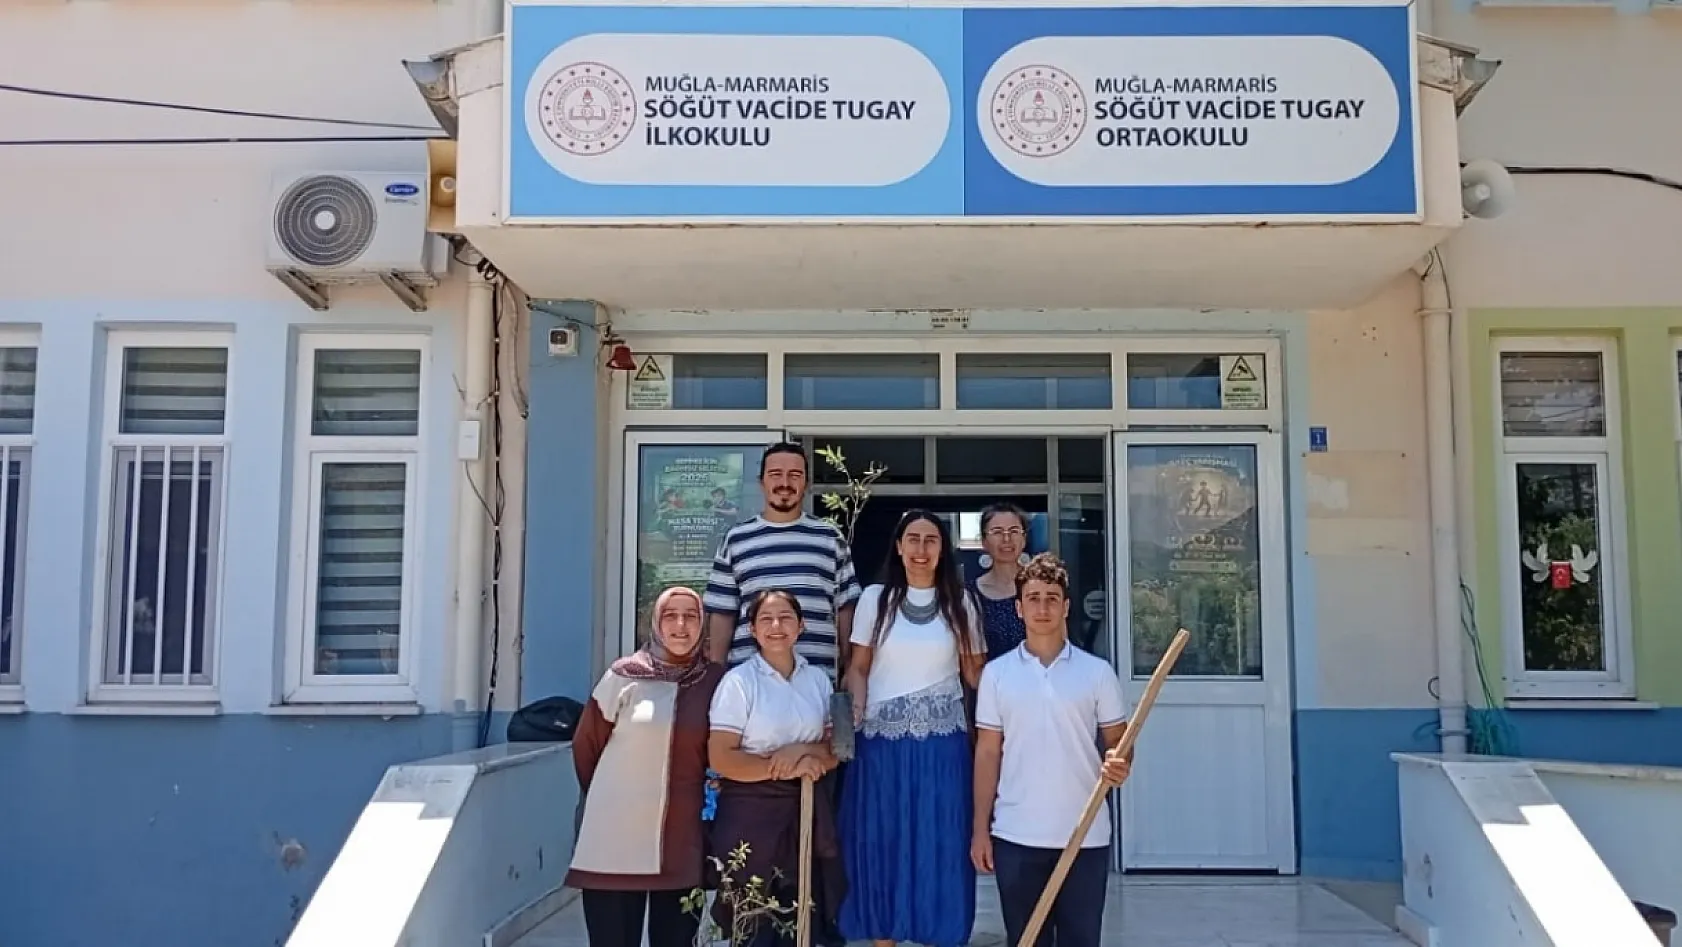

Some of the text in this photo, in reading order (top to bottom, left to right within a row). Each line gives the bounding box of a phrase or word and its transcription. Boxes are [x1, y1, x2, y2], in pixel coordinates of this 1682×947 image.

[646, 75, 829, 93] MUĞLA-MARMARİS
[1095, 75, 1276, 93] MUĞLA-MARMARİS
[645, 95, 916, 120] SÖĞÜT VACİDE TUGAY
[1095, 96, 1365, 120] SÖĞÜT VACİDE TUGAY
[647, 122, 770, 146] İLKOKULU
[1097, 127, 1248, 147] ORTAOKULU
